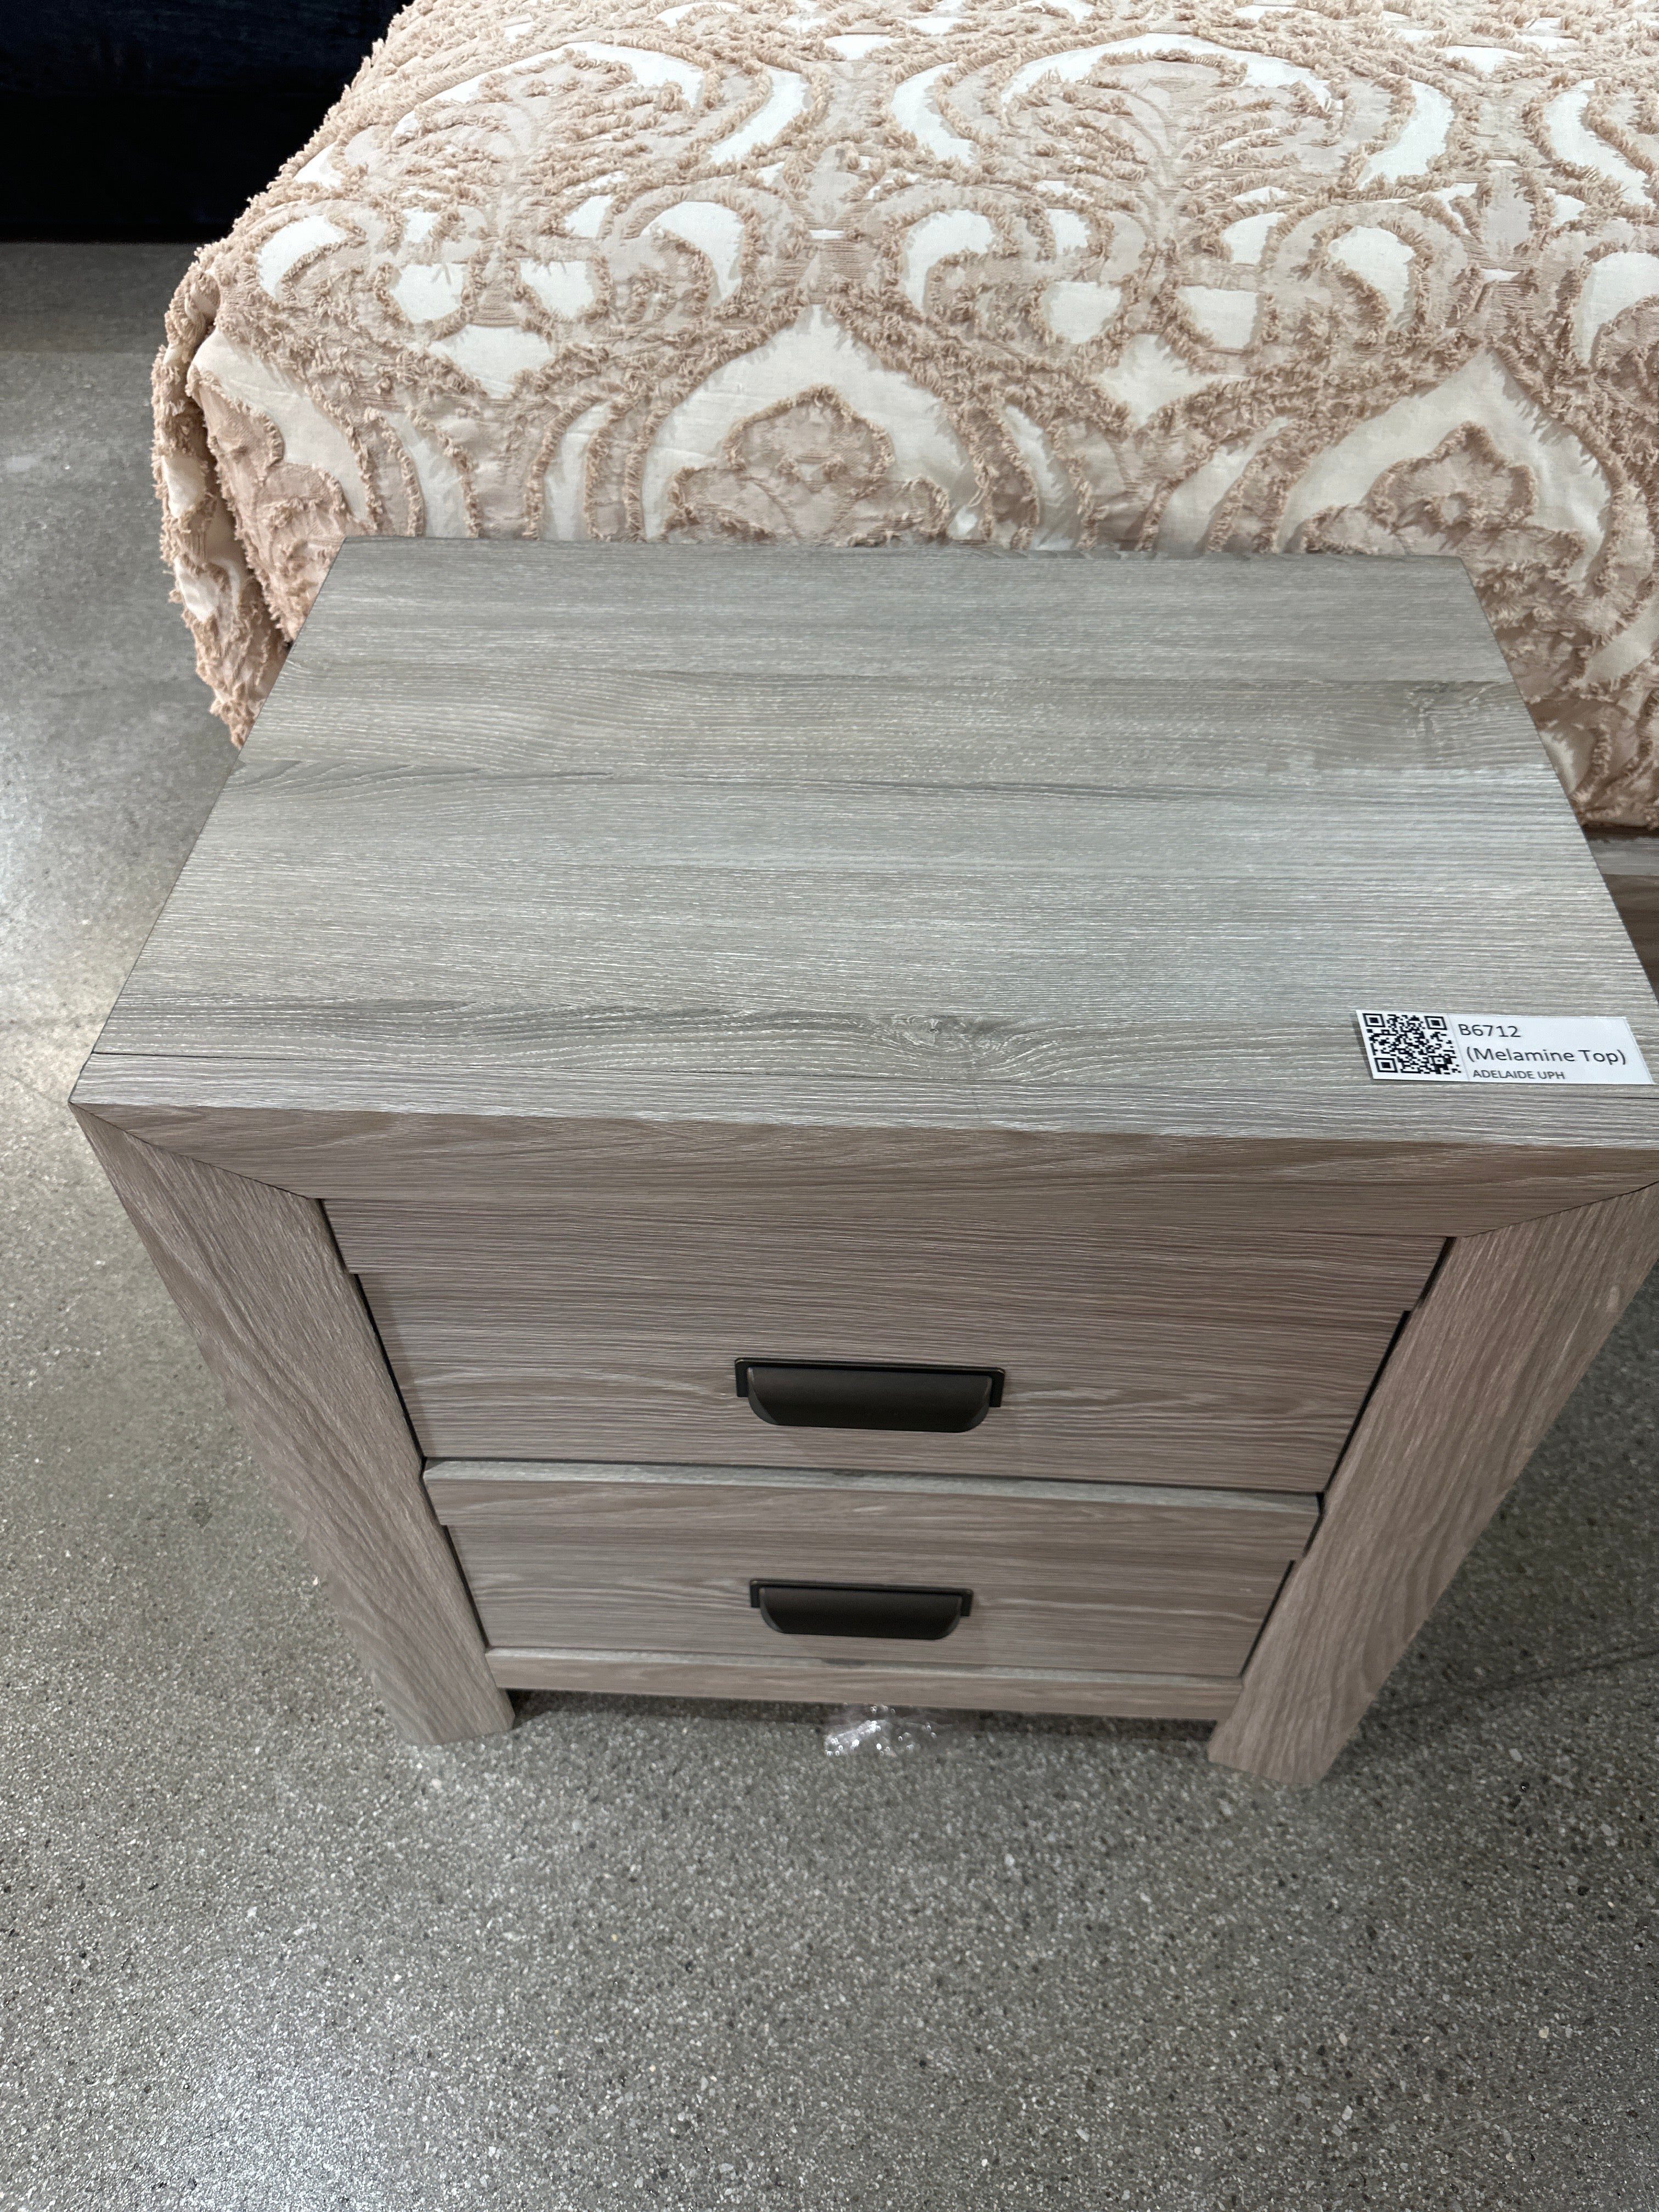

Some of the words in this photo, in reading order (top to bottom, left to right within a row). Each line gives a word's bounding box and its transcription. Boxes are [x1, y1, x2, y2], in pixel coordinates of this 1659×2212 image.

[1458, 1023, 1521, 1039] B6712
[1466, 1047, 1575, 1063] (Melamine
[1578, 1049, 1626, 1065] Top)
[1472, 1069, 1534, 1080] ADELAIDE
[1537, 1070, 1565, 1080] UPH
